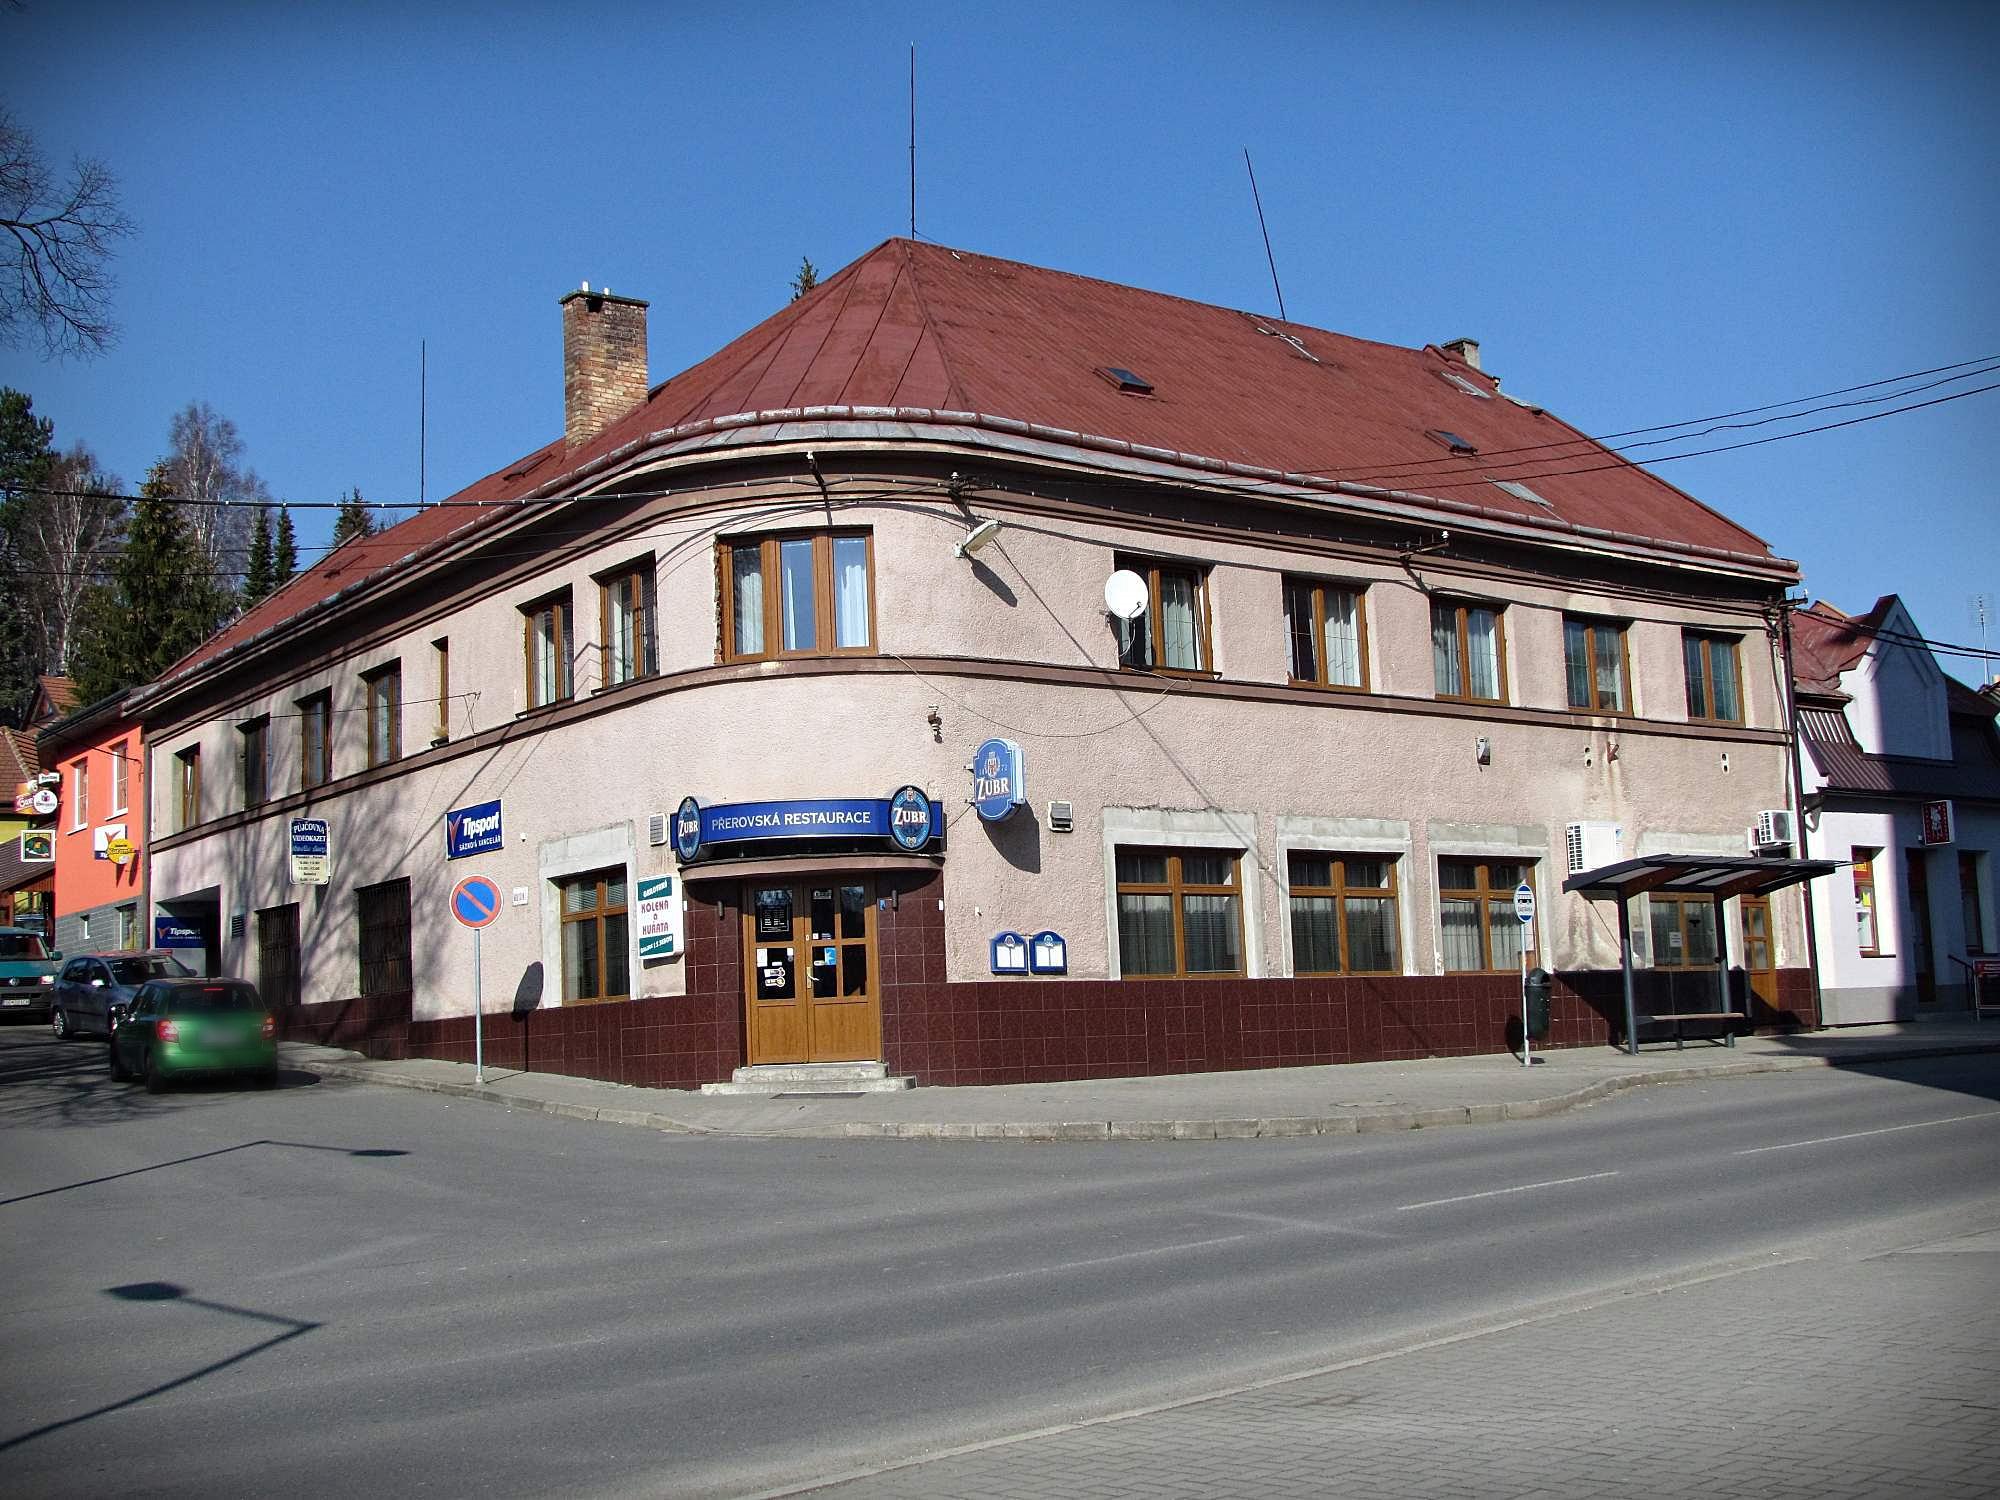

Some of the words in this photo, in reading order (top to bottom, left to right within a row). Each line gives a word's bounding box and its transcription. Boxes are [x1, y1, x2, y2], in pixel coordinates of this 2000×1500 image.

[977, 777, 1009, 800] ZUBR
[712, 812, 780, 830] PŘEROVSKÁ
[785, 812, 871, 826] RESTAURACE
[893, 807, 927, 825] ZUBR
[463, 812, 499, 839] Tipsport
[678, 819, 699, 837] ZUBR
[641, 900, 669, 913] KOLENA
[642, 921, 669, 935] KUŘATA
